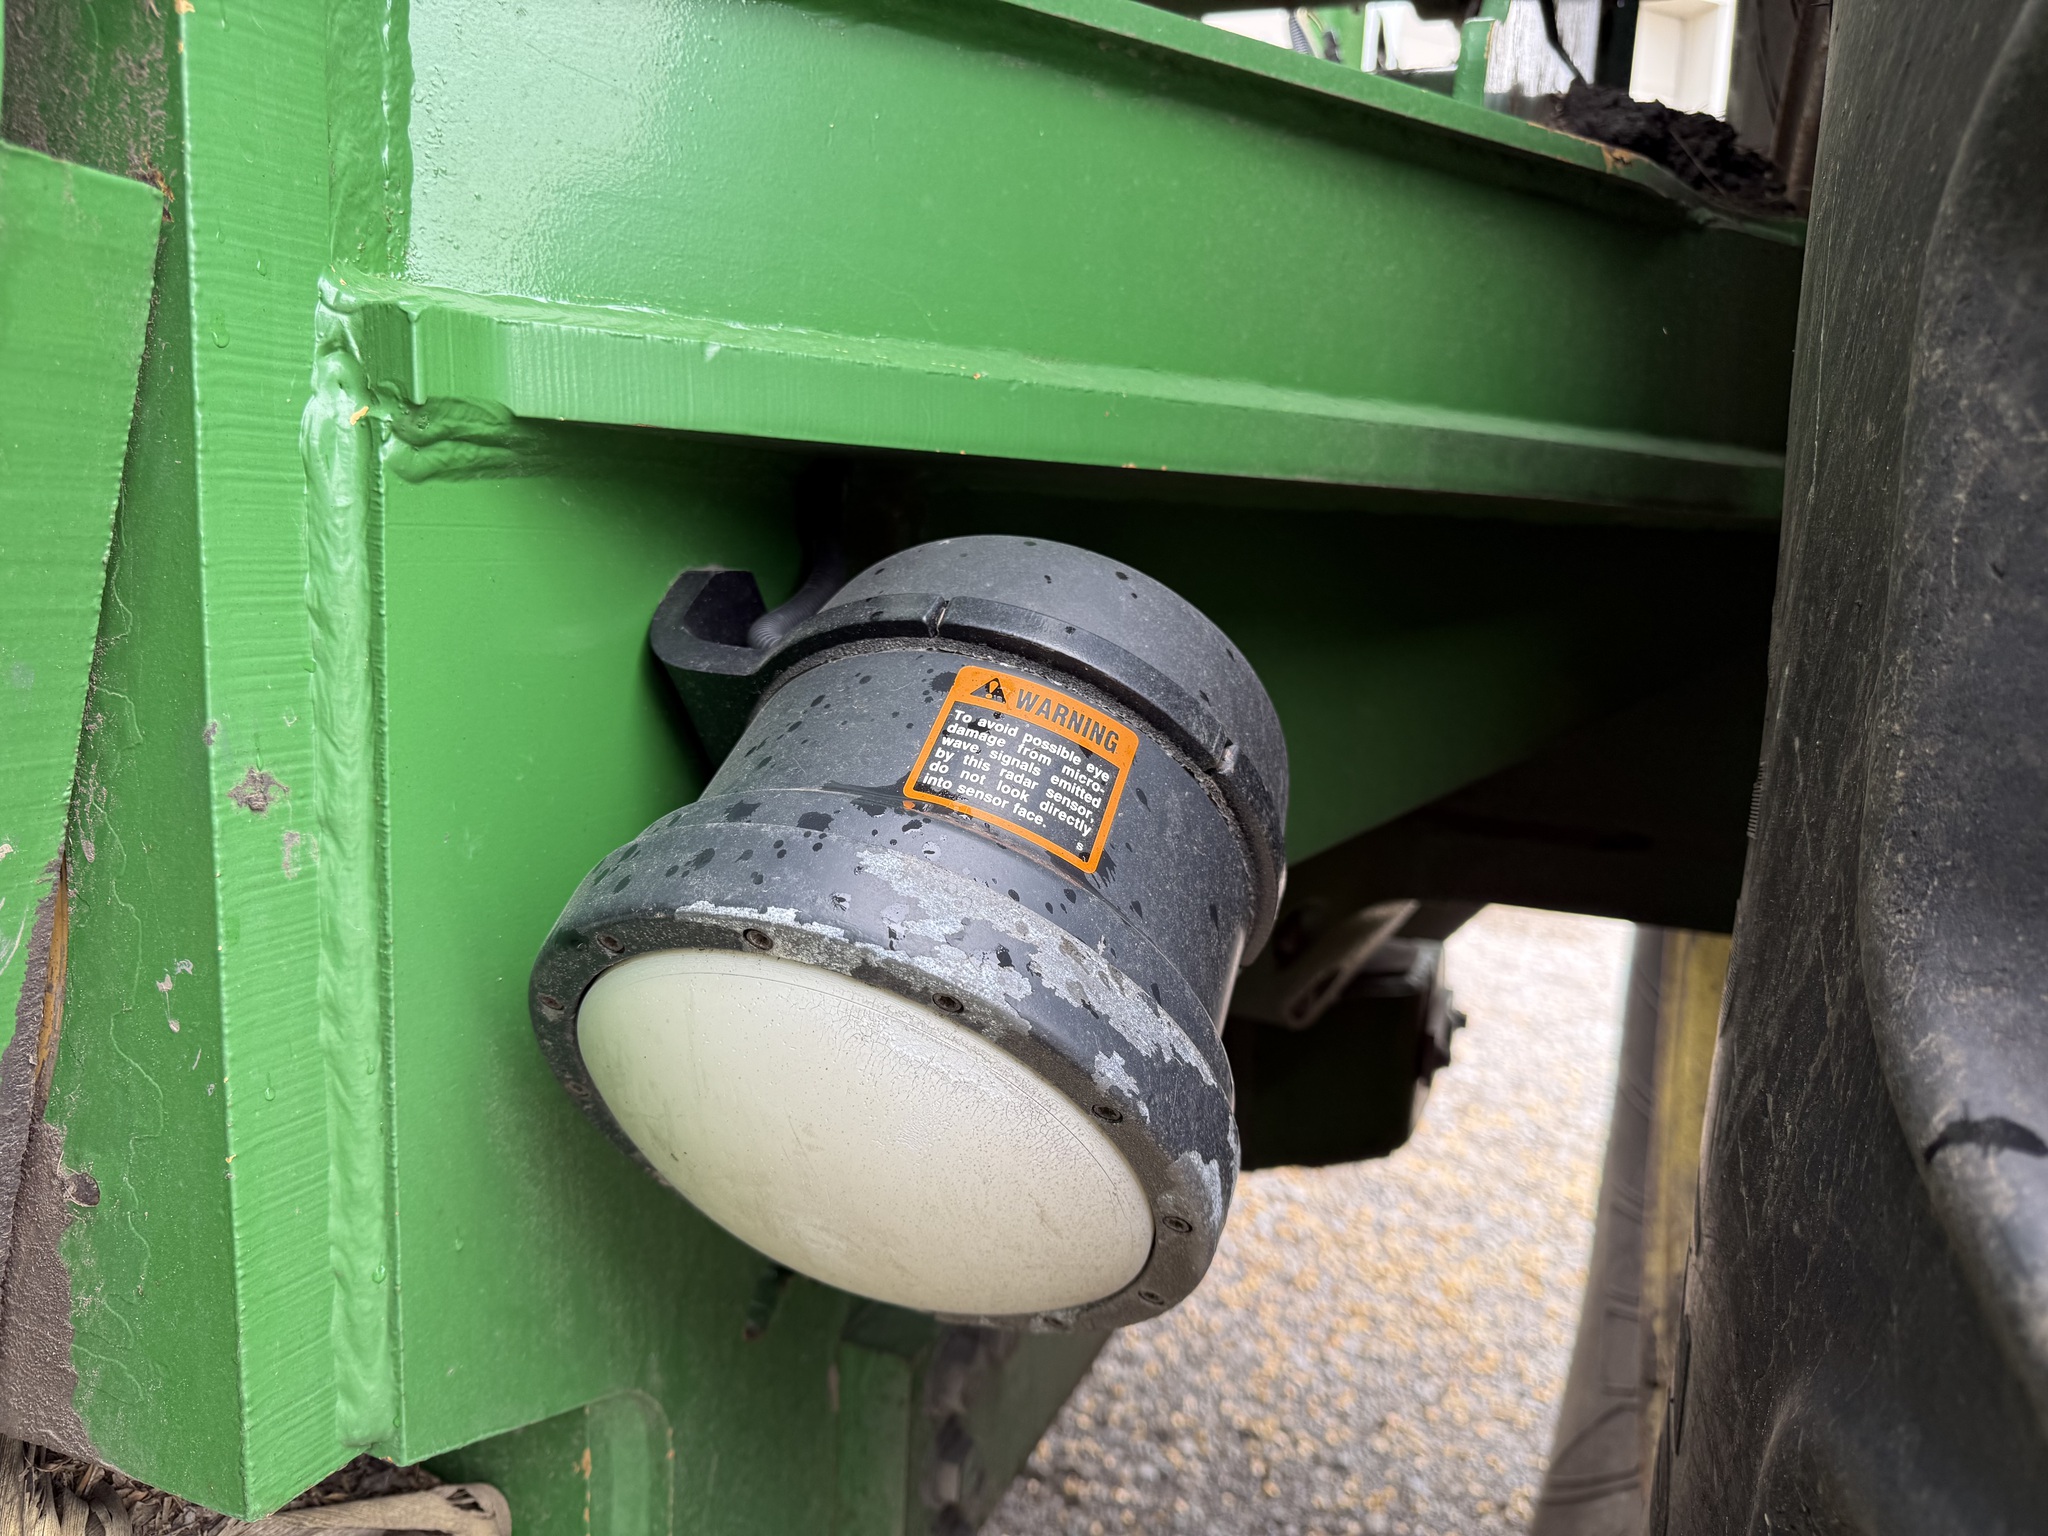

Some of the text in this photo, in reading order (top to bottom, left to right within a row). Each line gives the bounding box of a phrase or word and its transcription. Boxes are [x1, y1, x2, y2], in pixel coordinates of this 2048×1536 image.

[953, 710, 1110, 782] To avoid possible eye
[1015, 689, 1120, 754] WARNING
[934, 747, 1094, 823] by this radar sensor,
[942, 737, 1102, 808] wave signals emitted
[946, 724, 1105, 794] damage from micro-
[923, 774, 1046, 828] into sensor face.
[929, 761, 1092, 837] do not look directly
